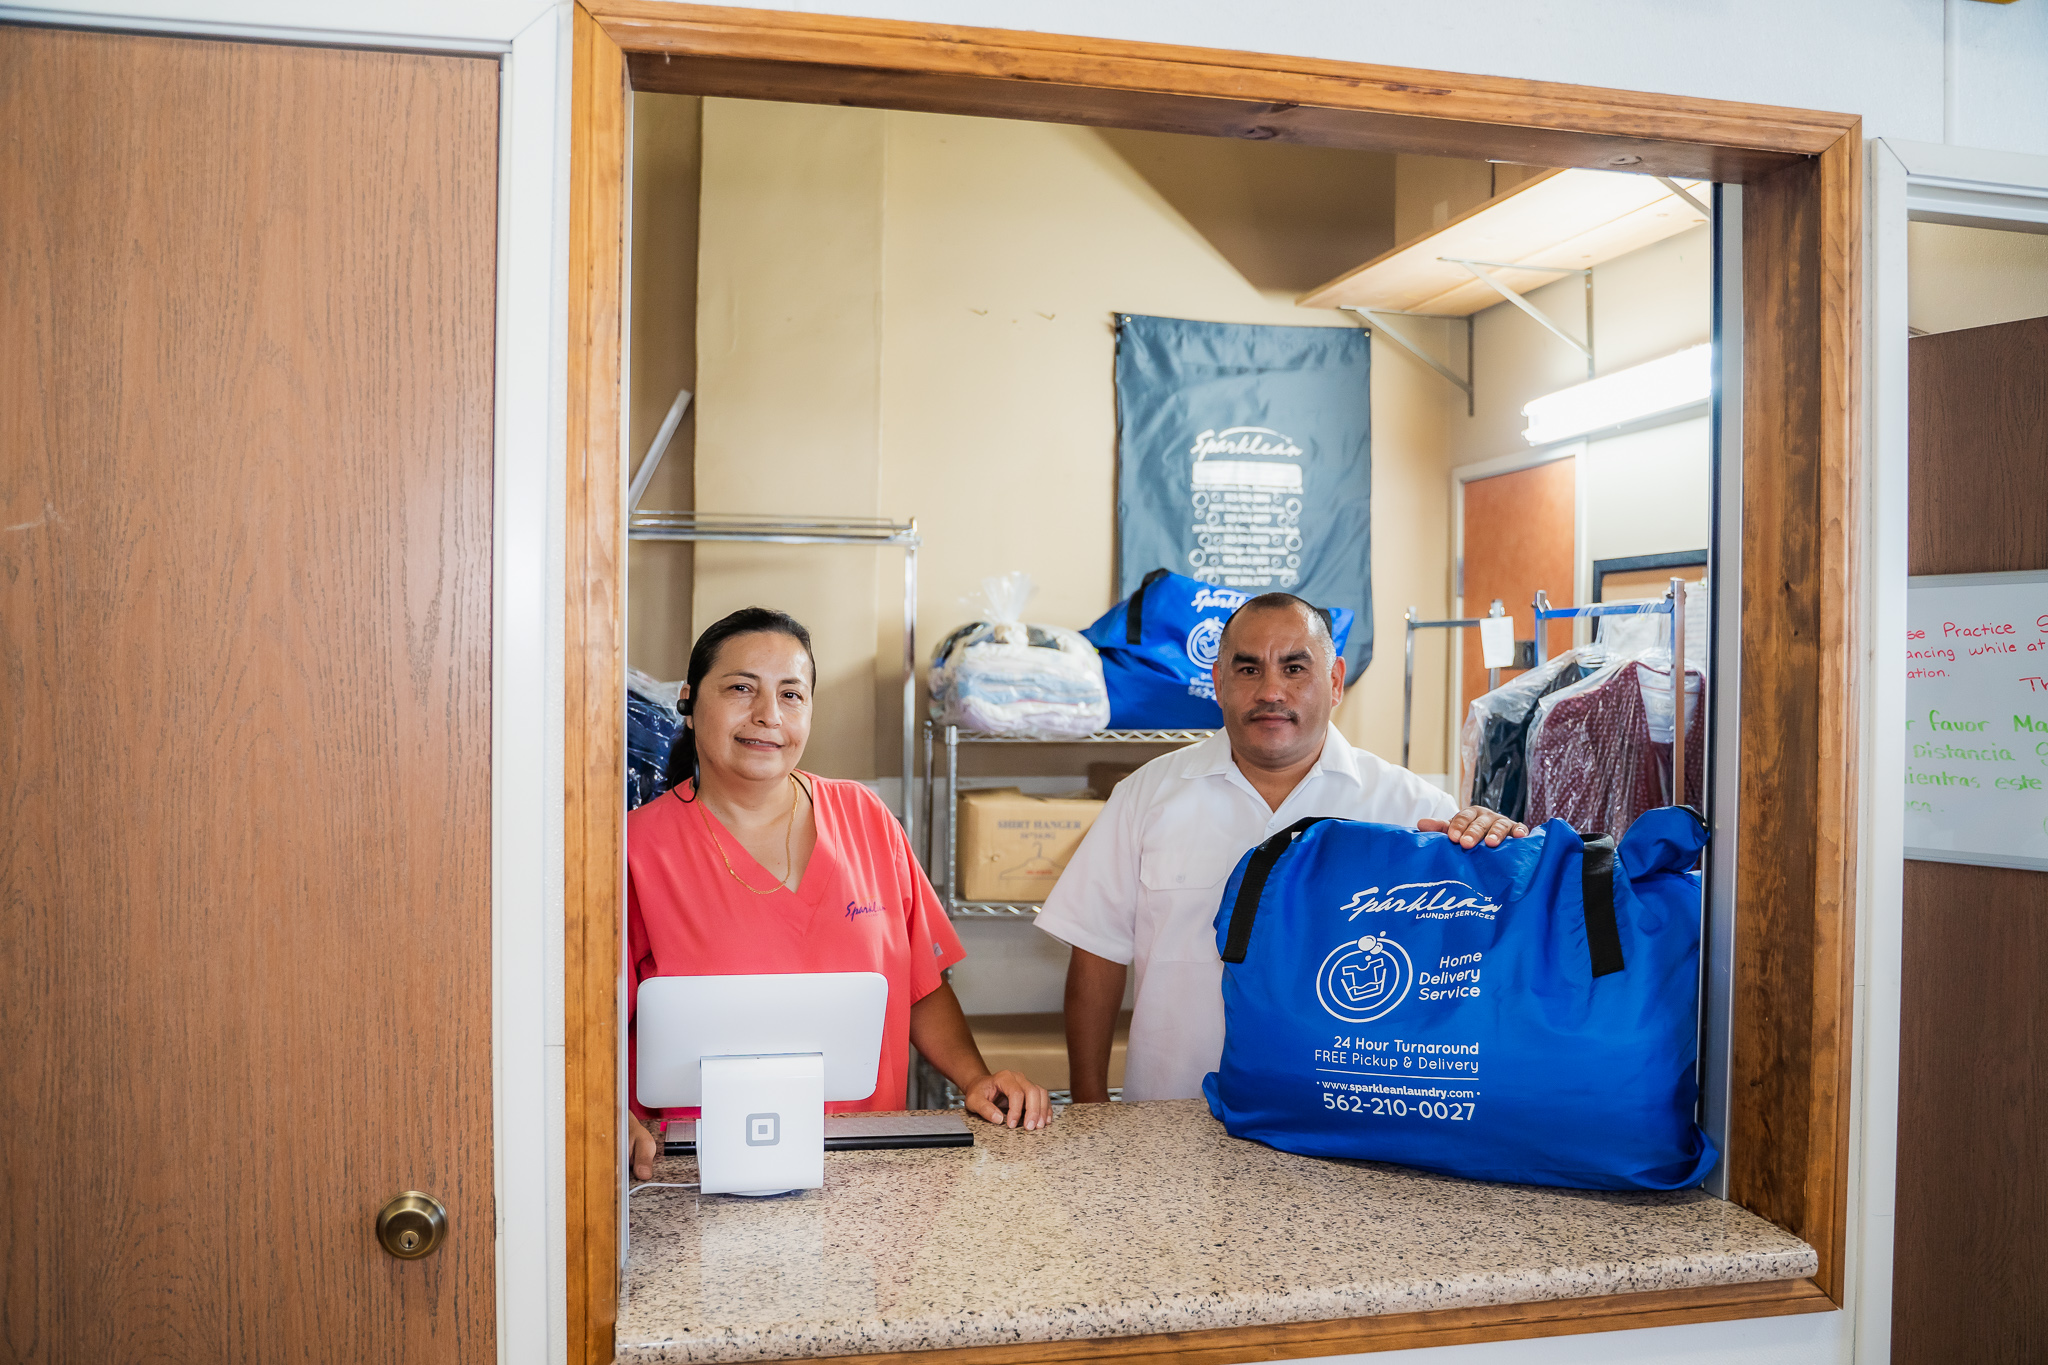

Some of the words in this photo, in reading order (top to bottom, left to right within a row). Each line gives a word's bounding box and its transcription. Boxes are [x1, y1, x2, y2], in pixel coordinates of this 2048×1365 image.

[1191, 588, 1250, 613] Sparkl
[1943, 621, 2016, 638] Practice
[1968, 642, 2017, 656] while
[2026, 638, 2046, 652] at
[1929, 709, 1991, 732] favor
[1913, 741, 2016, 761] Distancia
[1905, 766, 1981, 789] ientras
[1994, 774, 2043, 791] este
[1033, 820, 1082, 830] HANGER
[1340, 884, 1502, 922] Sparklean
[1415, 912, 1453, 920] LAUNDRY
[1455, 910, 1496, 920] SERVICES
[1439, 952, 1483, 969] Home
[1418, 968, 1481, 986] Delivery
[1418, 986, 1481, 1001] Service
[1333, 1035, 1351, 1049] 24
[1355, 1037, 1389, 1052] Hour
[1394, 1039, 1479, 1055] Turnaround
[1314, 1049, 1347, 1064] FREE
[1352, 1052, 1398, 1070] Pickup
[1403, 1056, 1413, 1069] &
[1418, 1056, 1479, 1073] Delivery
[1321, 1081, 1474, 1099] www.sparkleanlaundry.com
[1323, 1092, 1476, 1121] 562-210-0027
